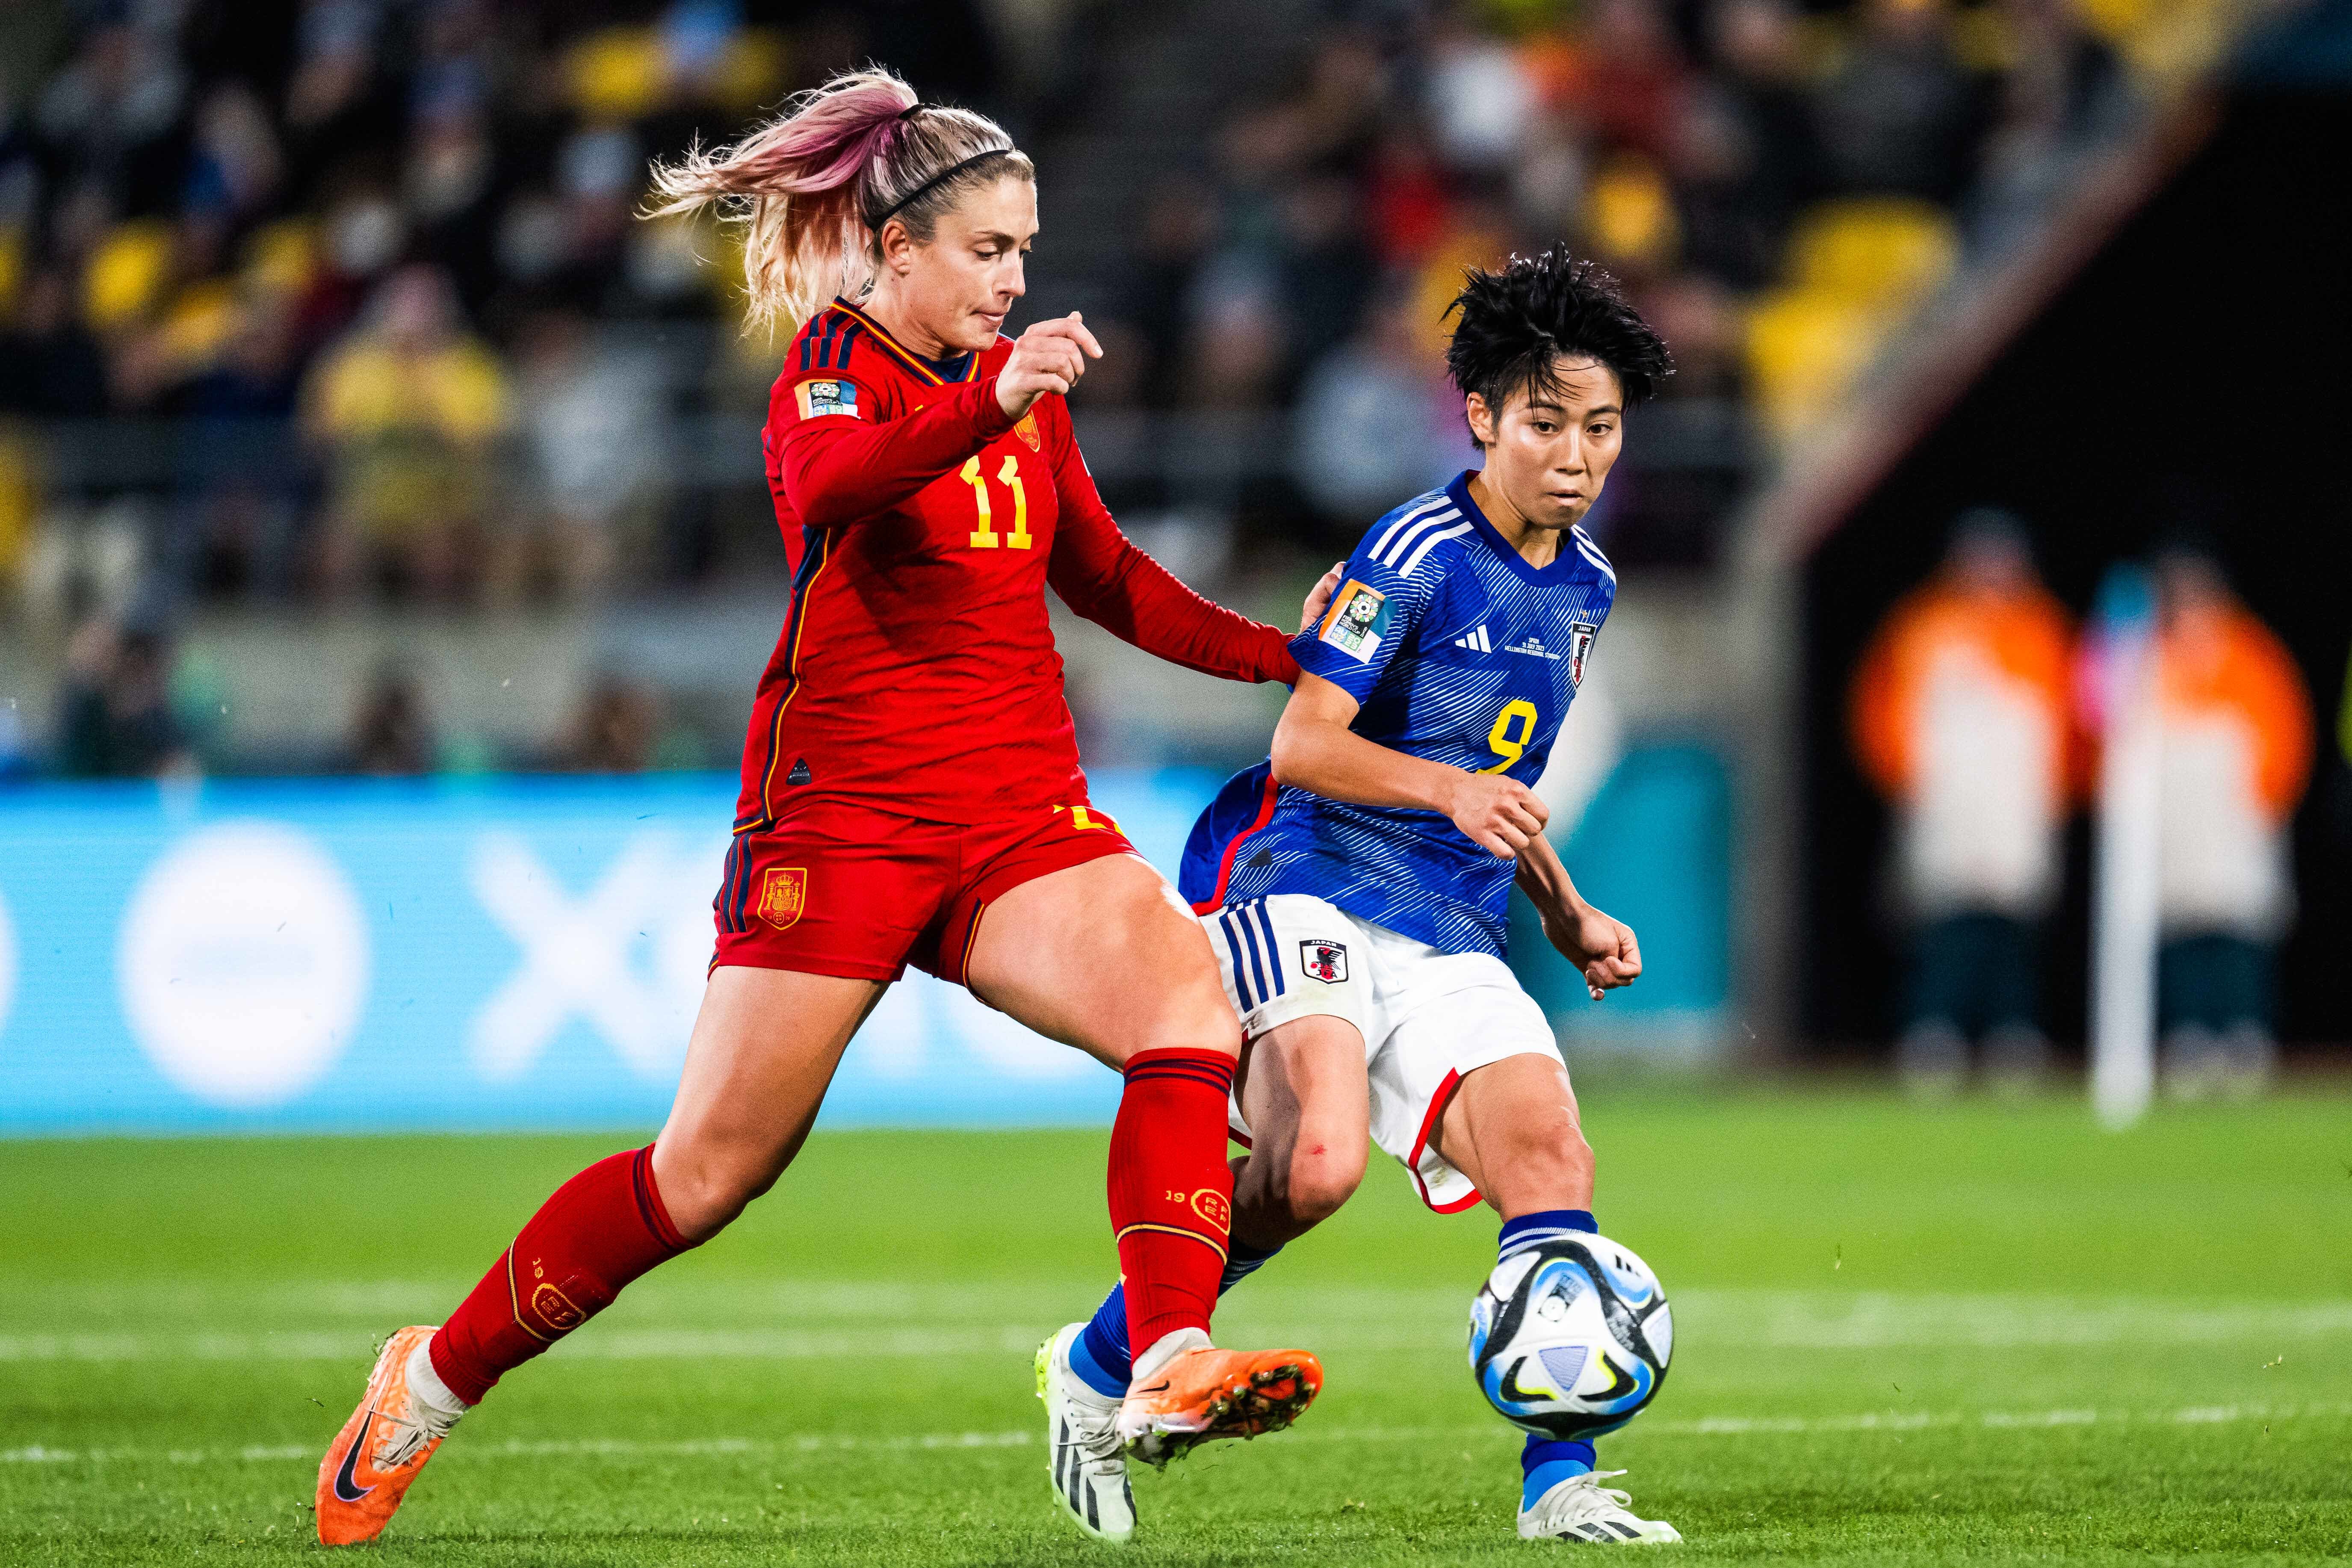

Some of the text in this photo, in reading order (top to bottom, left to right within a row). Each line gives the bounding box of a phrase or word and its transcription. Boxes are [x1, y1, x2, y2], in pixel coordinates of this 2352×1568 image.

[959, 455, 1032, 549] 11
[1339, 621, 1352, 630] WORLD
[1341, 618, 1359, 630] WOMEN'S
[1505, 645, 1560, 660] WELLINGTON REGIONAL STADIUM
[1476, 699, 1538, 775] 9
[1165, 1190, 1185, 1203] 19
